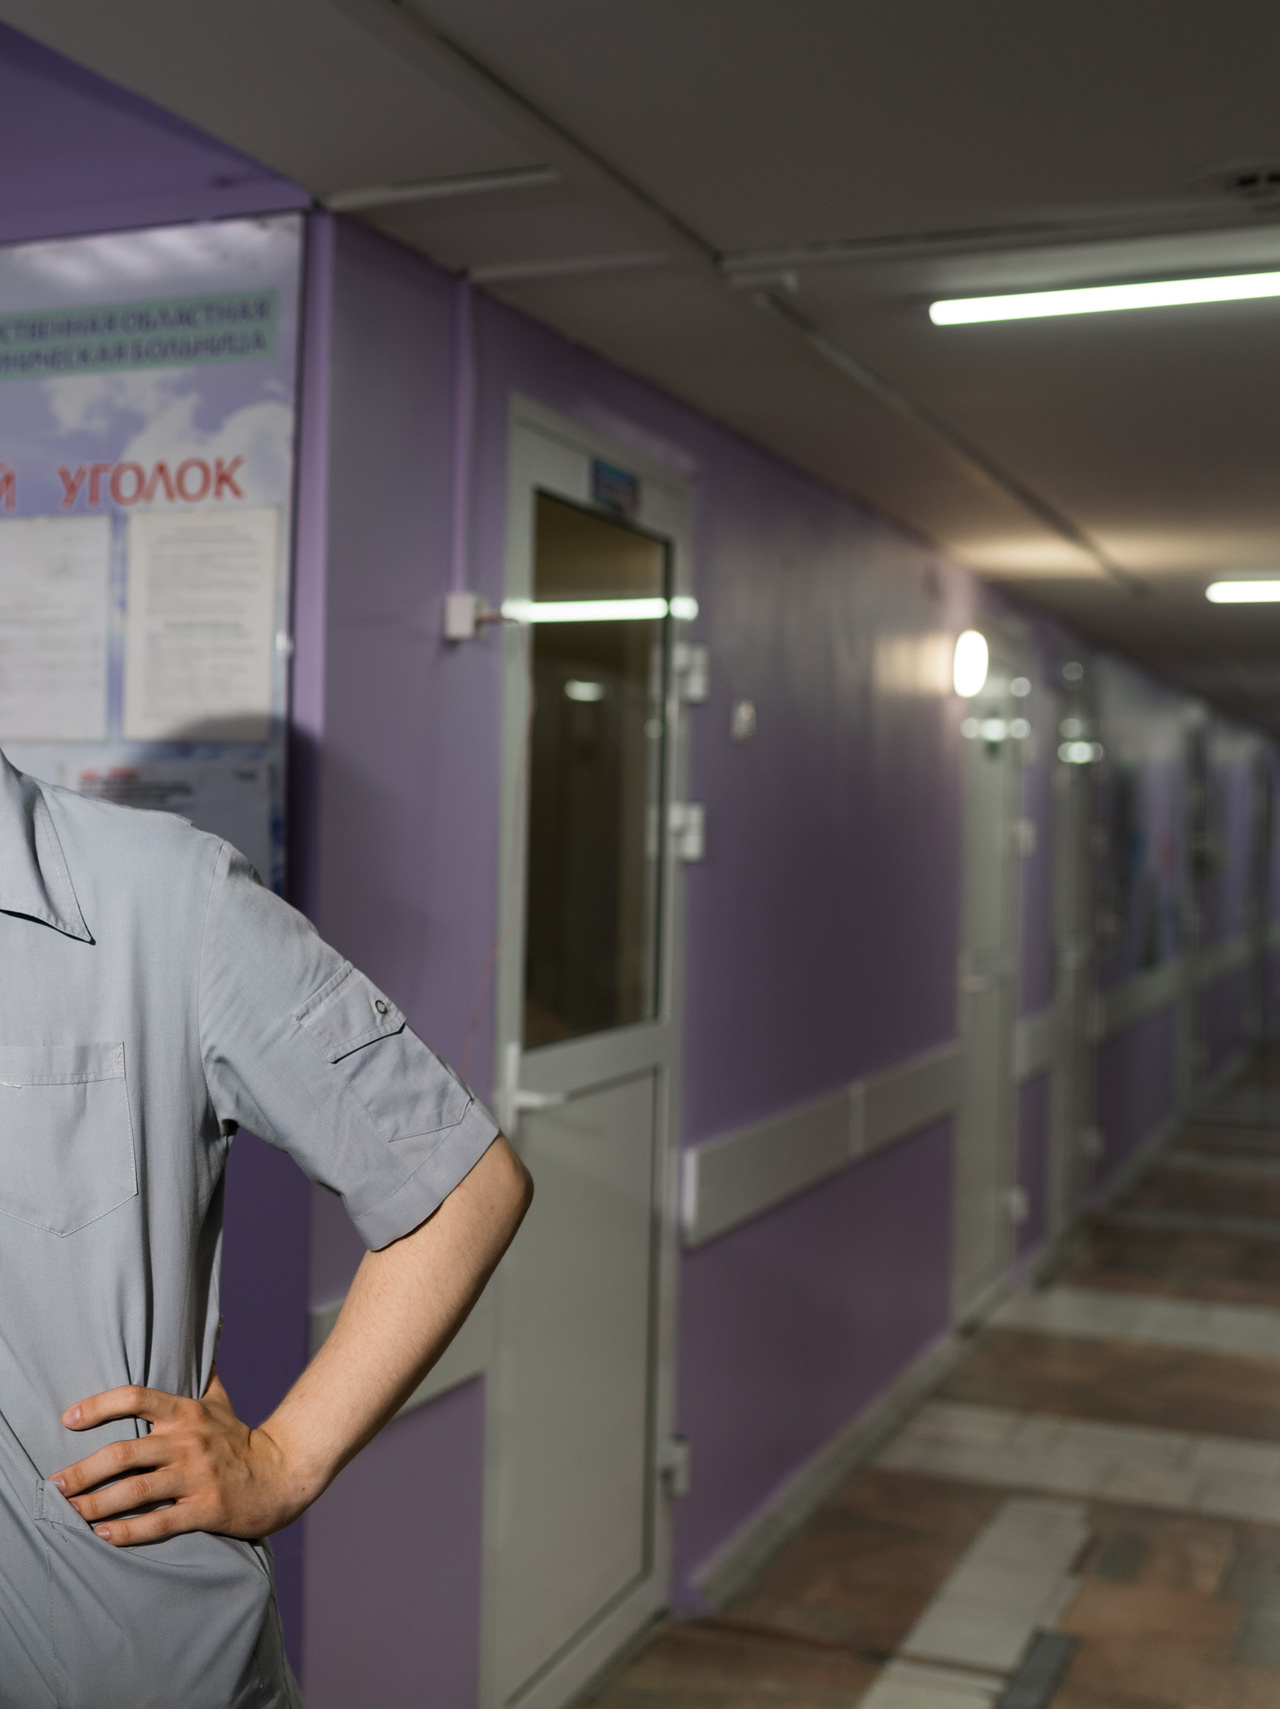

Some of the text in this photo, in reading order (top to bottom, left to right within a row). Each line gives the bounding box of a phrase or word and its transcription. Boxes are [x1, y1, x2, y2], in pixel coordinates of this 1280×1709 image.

[120, 296, 272, 334] ОБЛАСТНАЯ
[129, 328, 268, 366] БОЛЬНИЦА
[55, 455, 246, 510] УГОЛОК
